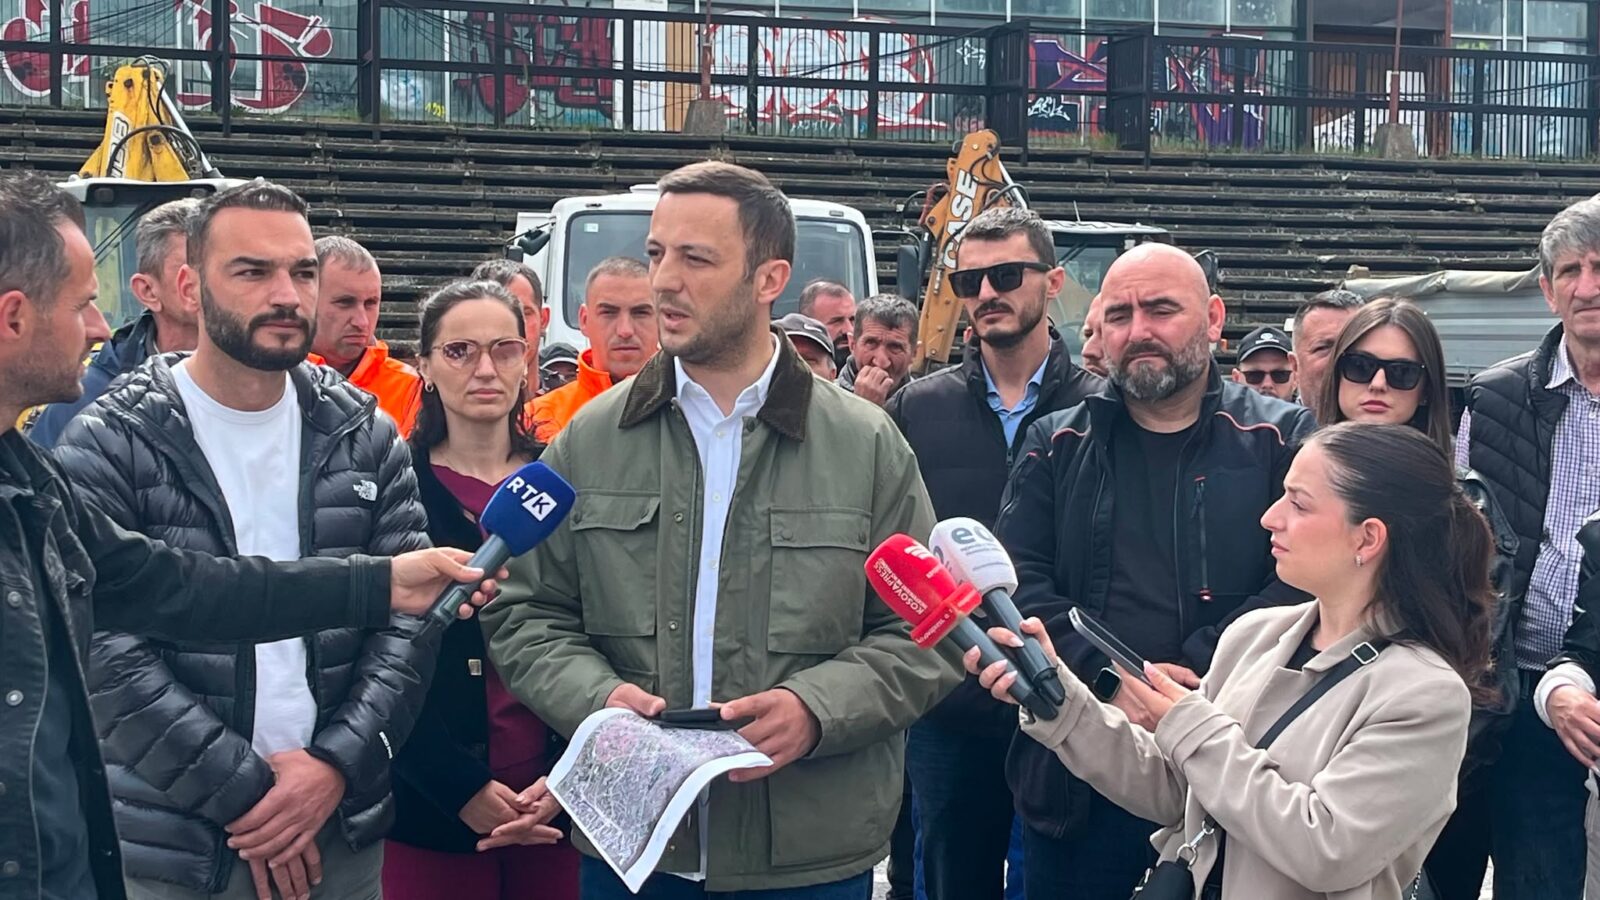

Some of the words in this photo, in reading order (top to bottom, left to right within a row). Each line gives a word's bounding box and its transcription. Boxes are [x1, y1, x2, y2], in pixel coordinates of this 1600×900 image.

[942, 168, 978, 269] CASE
[506, 476, 553, 517] RTK
[873, 560, 924, 615] KOSOVAPRESS
